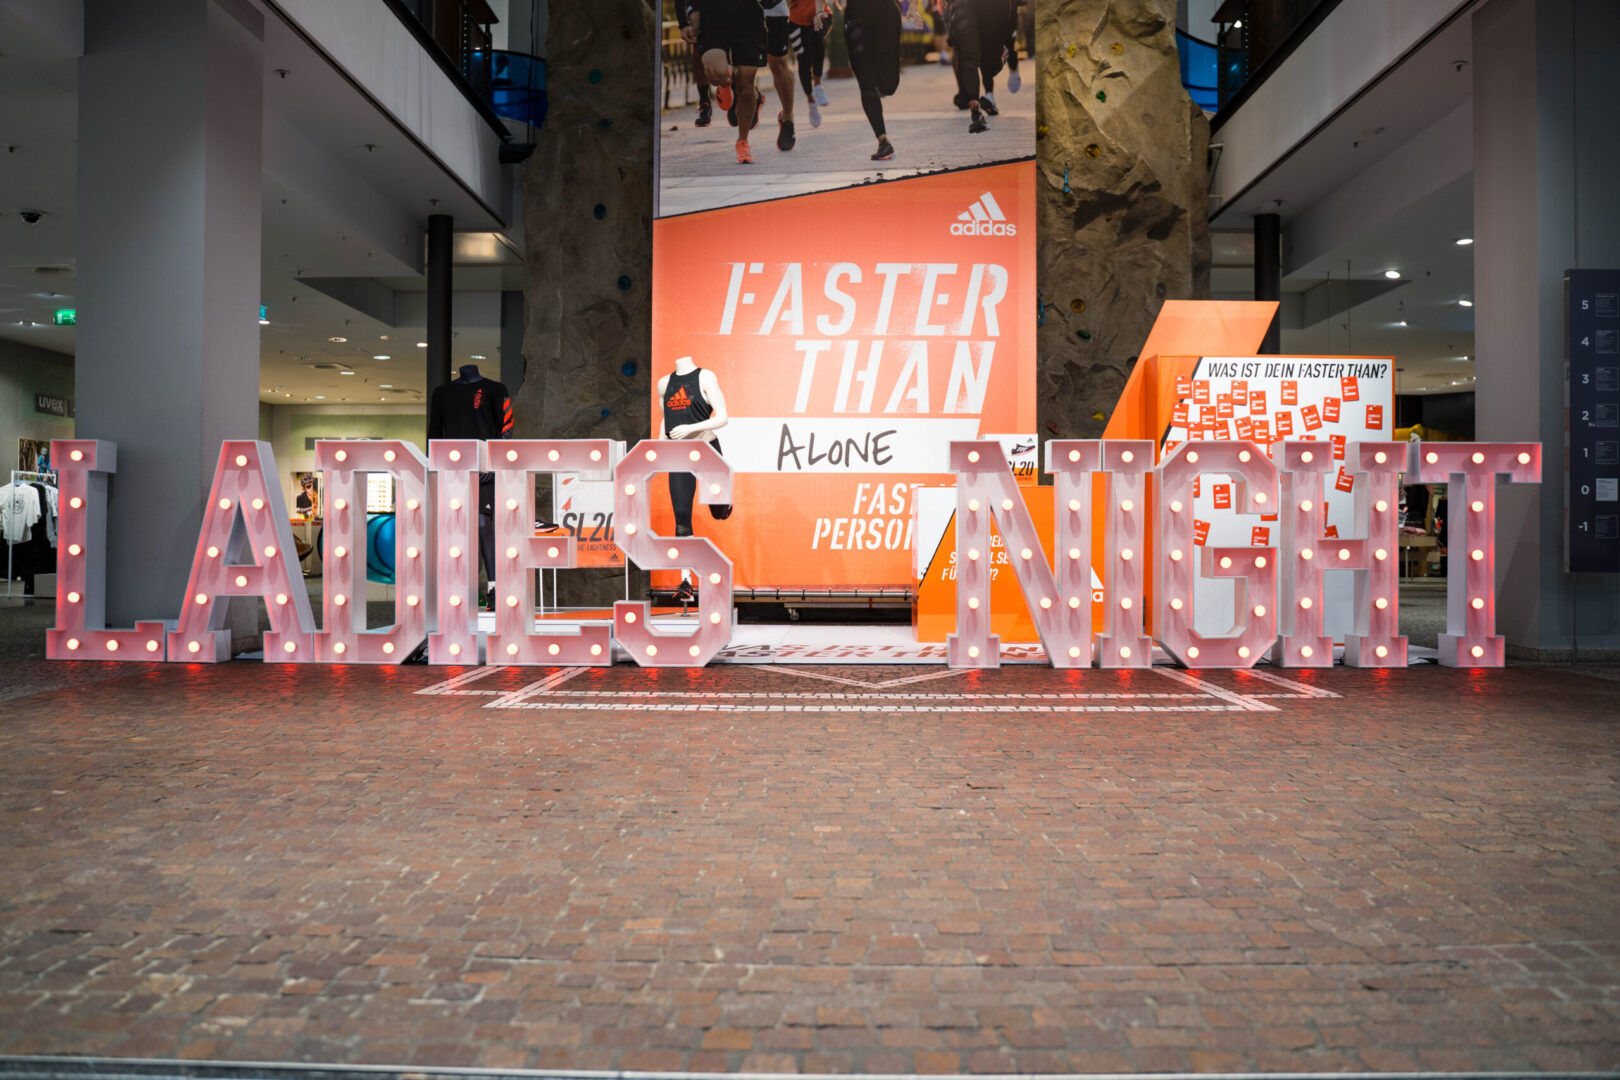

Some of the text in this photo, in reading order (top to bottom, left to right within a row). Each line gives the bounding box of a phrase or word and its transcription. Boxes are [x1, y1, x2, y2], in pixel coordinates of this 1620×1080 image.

[950, 220, 1017, 236] adidas
[718, 262, 1009, 337] FASTER
[1581, 299, 1590, 310] 5
[1581, 336, 1590, 347] 4
[793, 339, 997, 414] THAN
[1208, 362, 1388, 379] WAS IST DEIN FASTER THAN?
[1581, 374, 1590, 385] 3
[38, 395, 64, 410] uvex
[1581, 410, 1590, 421] 2
[777, 423, 898, 471] ALONE
[1583, 447, 1589, 458] 1
[1580, 485, 1590, 496] 0
[46, 438, 1543, 669] LADIES NIGHT
